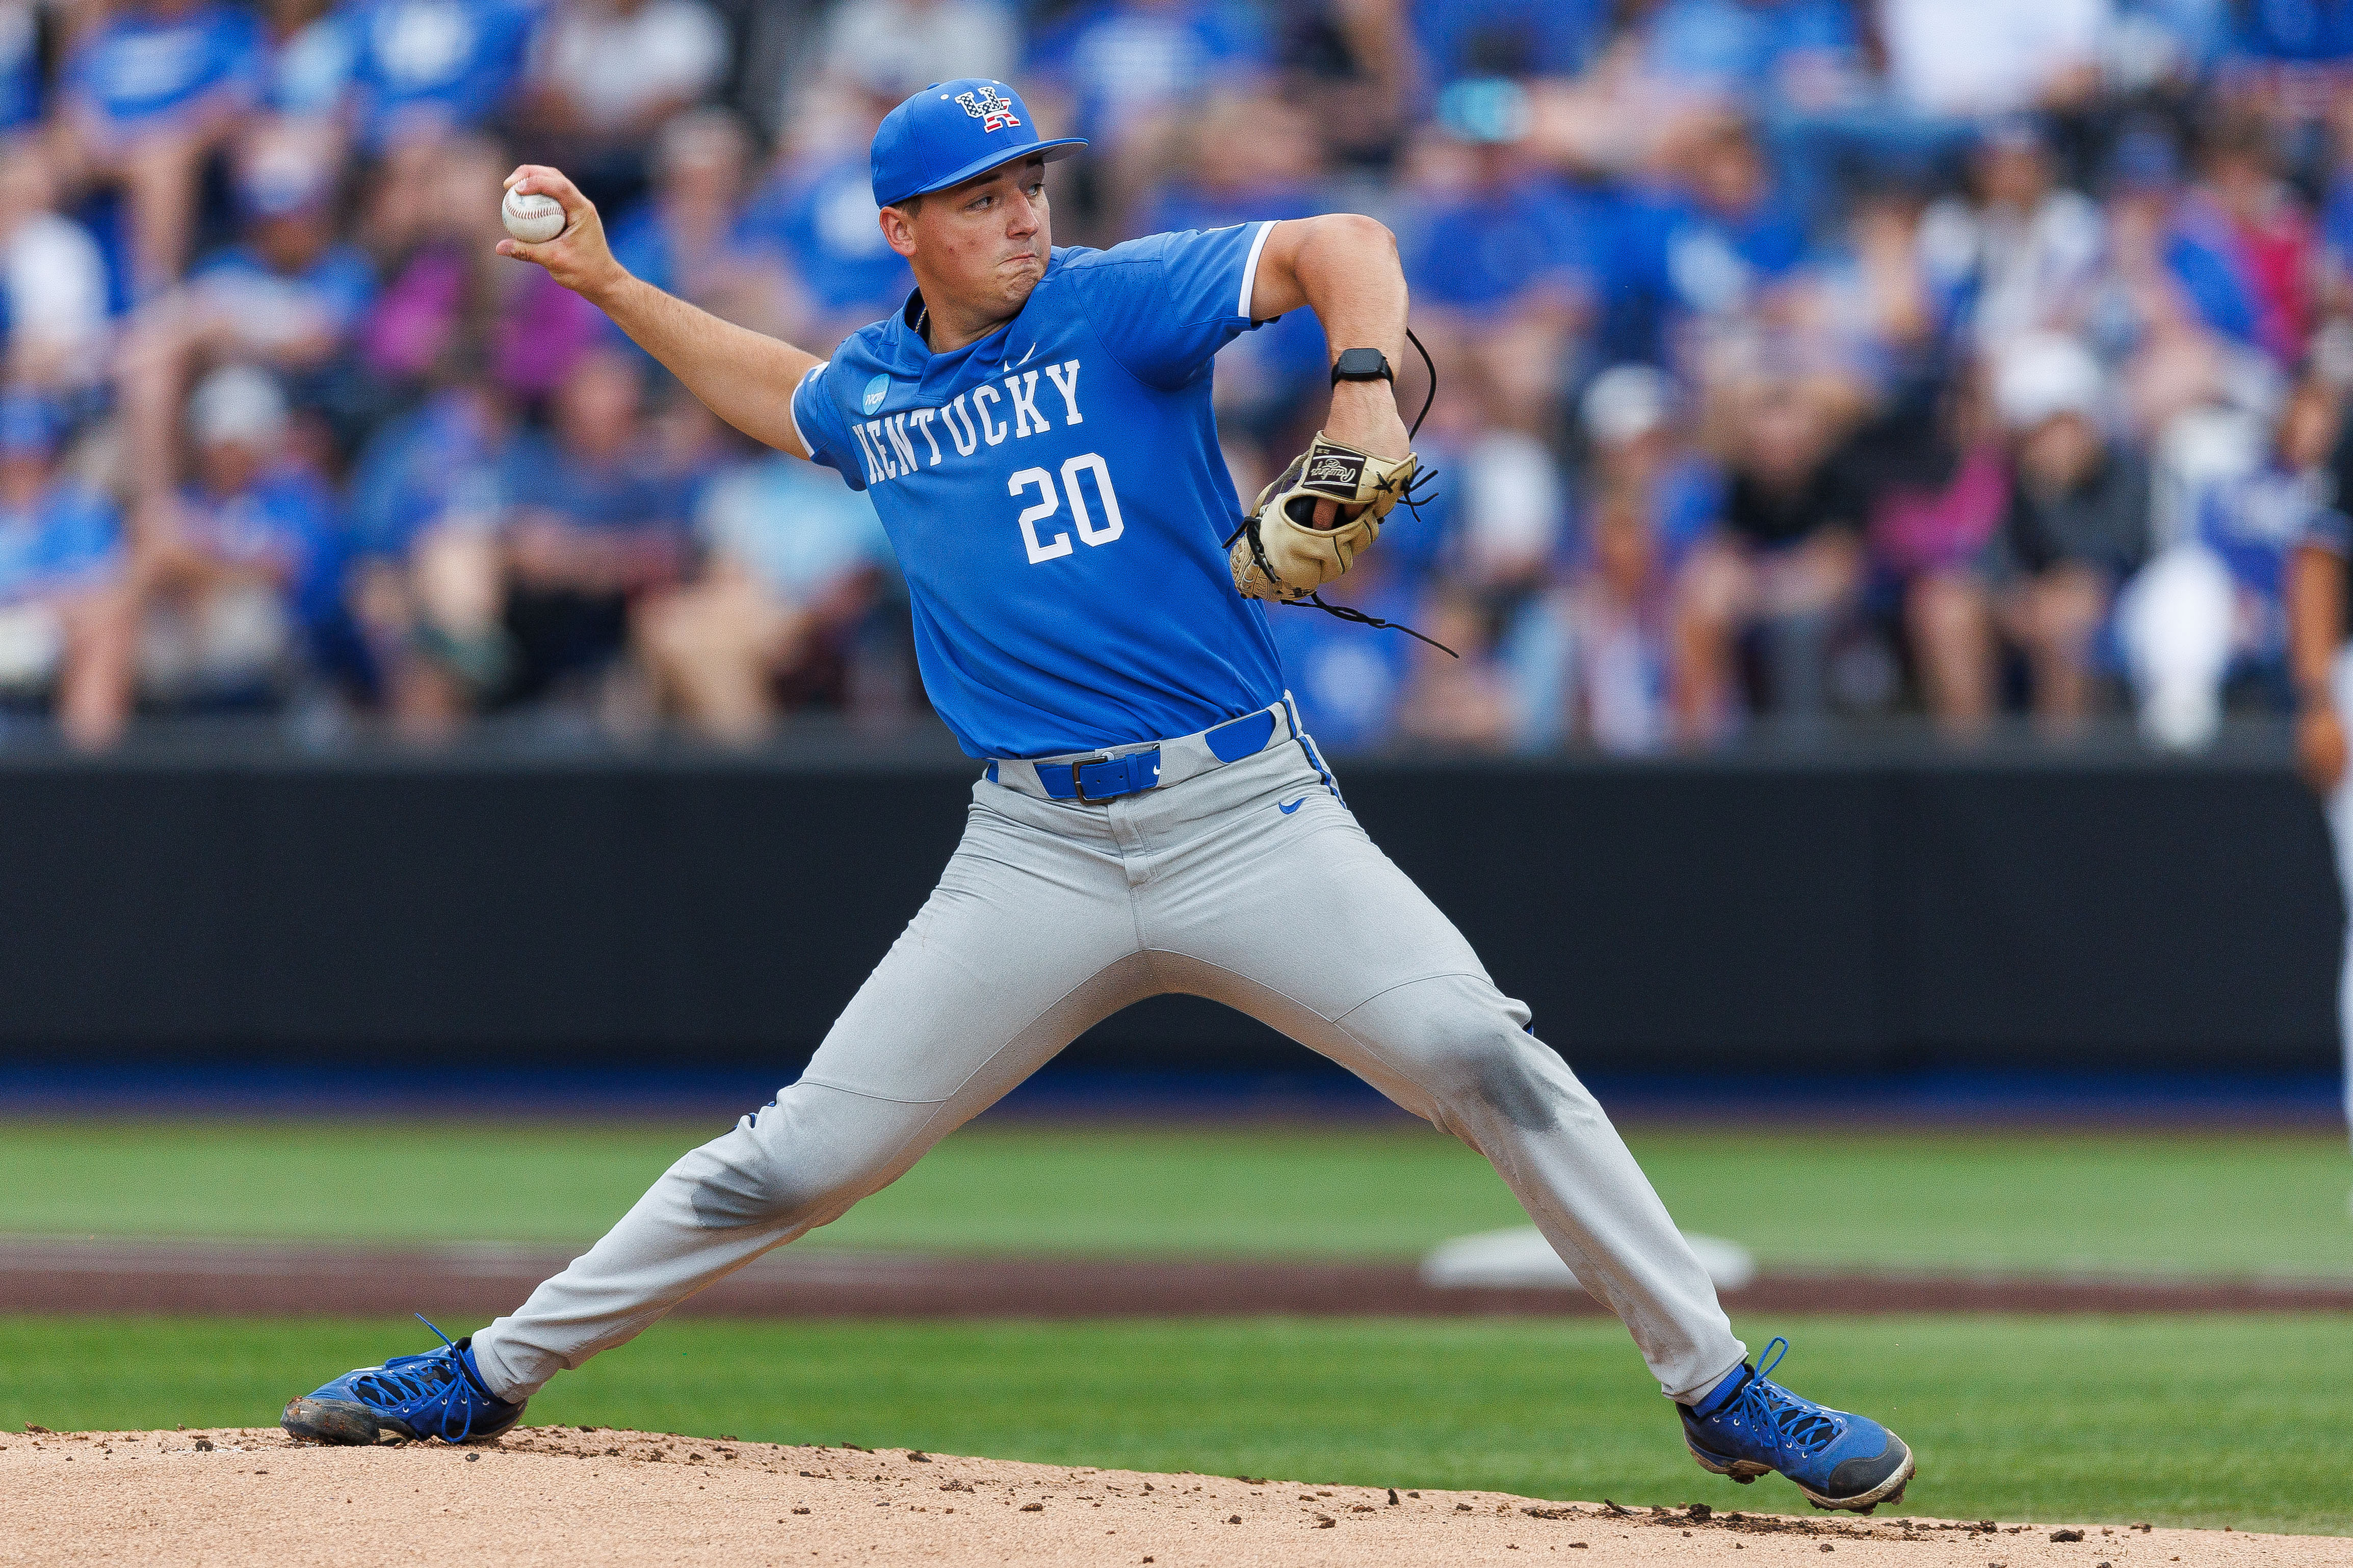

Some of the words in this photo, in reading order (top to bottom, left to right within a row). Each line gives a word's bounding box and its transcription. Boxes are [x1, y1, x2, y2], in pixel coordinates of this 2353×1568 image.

[954, 86, 1021, 134] UK
[852, 359, 1083, 485] KENTUCKY
[1007, 452, 1125, 565] 20
